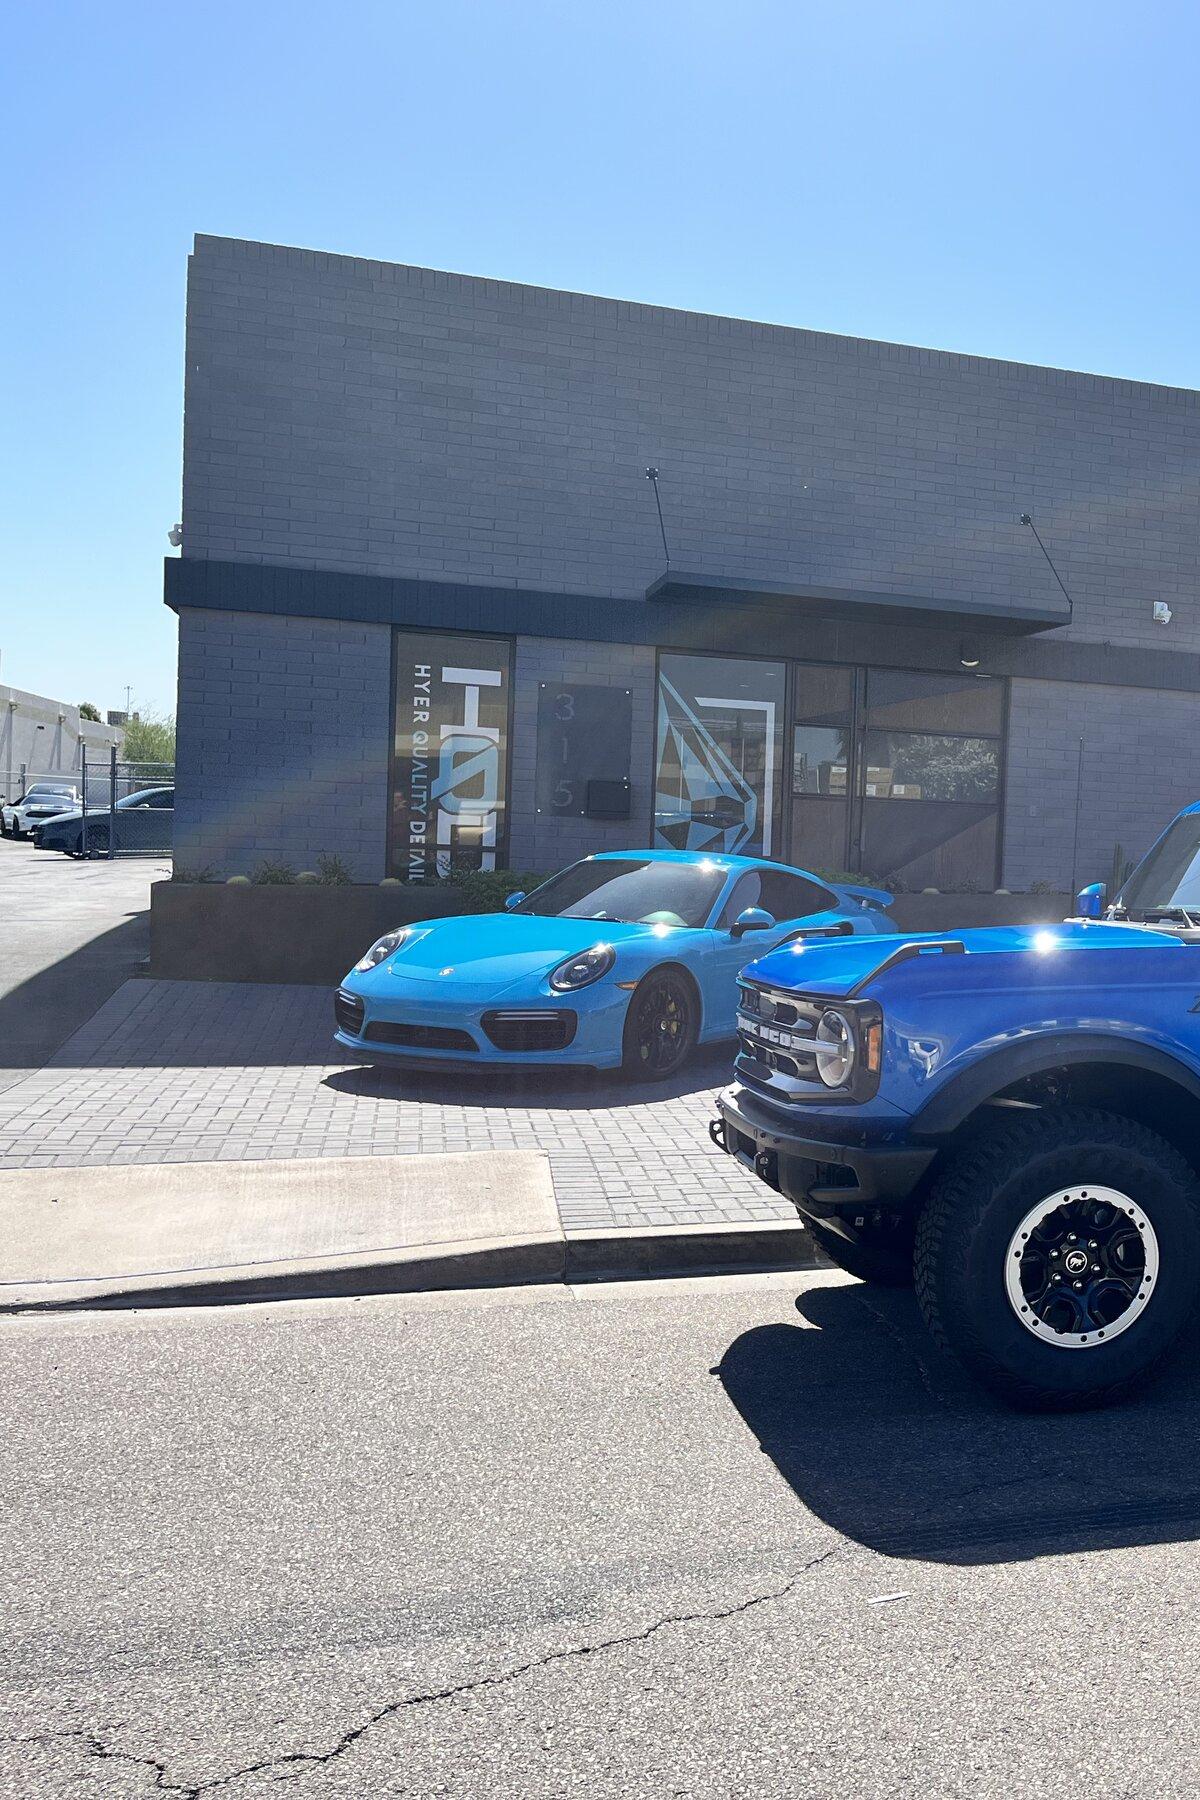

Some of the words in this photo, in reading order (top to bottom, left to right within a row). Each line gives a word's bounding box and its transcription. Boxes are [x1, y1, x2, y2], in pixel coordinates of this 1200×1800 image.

[413, 664, 431, 723] HYER
[410, 730, 429, 815] QUALITY
[552, 693, 575, 807] 315
[408, 821, 426, 880] DETAIL
